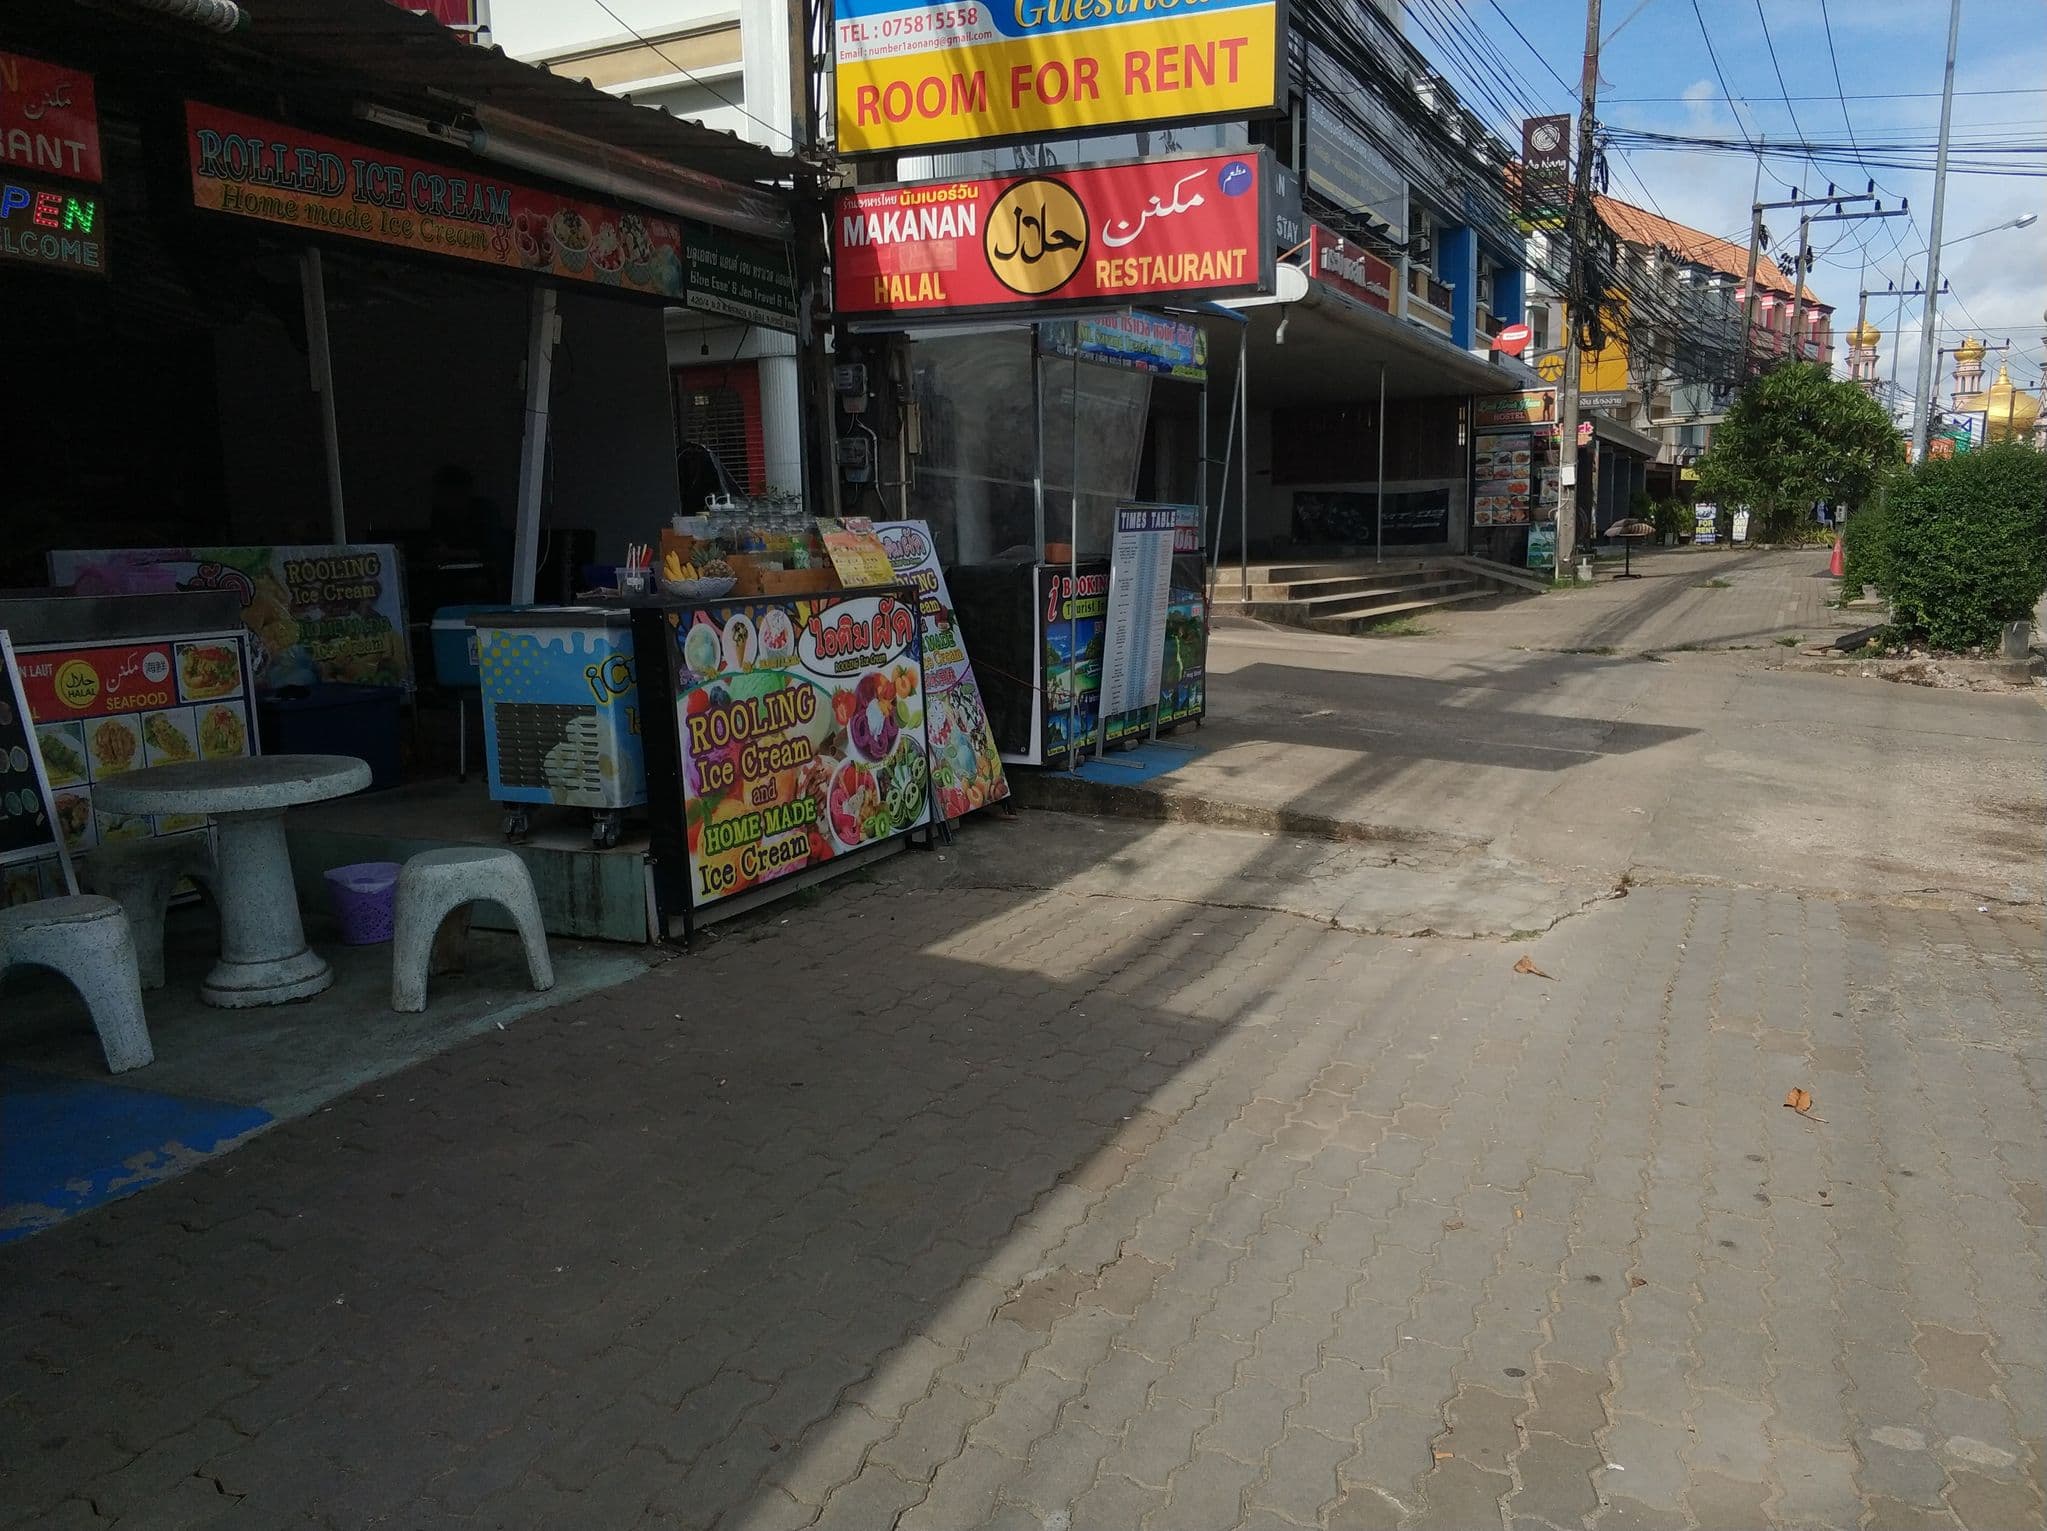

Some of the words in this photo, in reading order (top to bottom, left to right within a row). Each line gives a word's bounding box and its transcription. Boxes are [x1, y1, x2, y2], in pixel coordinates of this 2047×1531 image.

[840, 22, 869, 44] TEL
[882, 8, 978, 37] 075815558
[869, 31, 992, 56] number1aonang@gmail.com
[857, 71, 987, 127] ROOM
[1011, 57, 1100, 109] FOR
[1125, 37, 1248, 95] RENT
[0, 127, 87, 173] ANT
[196, 129, 346, 197] ROLLED
[352, 159, 407, 210] ICE
[410, 170, 512, 229] CREAM
[900, 184, 979, 206] นัมเบอร์วัน
[0, 184, 96, 235] PEN
[222, 183, 298, 219] Home
[304, 203, 374, 232] made
[380, 209, 414, 240] Ice
[420, 216, 488, 250] Cream
[843, 203, 977, 247] MAKANAN
[0, 226, 100, 267] LCOME
[994, 203, 1083, 264] حلال
[1096, 248, 1247, 288] RESTAURANT
[873, 271, 946, 304] HALAL
[1121, 511, 1147, 529] TIMES
[1151, 511, 1176, 528] TABLE
[1695, 526, 1716, 534] RENT
[1698, 519, 1714, 527] FOR
[286, 555, 379, 583] ROOLING
[295, 586, 320, 604] Ice
[323, 583, 378, 602] Cream
[919, 600, 941, 614] eam
[1066, 600, 1095, 616] Turist
[30, 663, 53, 678] LAUT
[68, 687, 96, 698] HALAL
[106, 691, 168, 712] SEAFOOD
[688, 684, 816, 754] ROOLING
[698, 760, 734, 794] Ice
[741, 737, 812, 782] Cream
[752, 778, 778, 806] and
[705, 812, 762, 855] HOME
[764, 797, 817, 838] MADE
[699, 861, 735, 896] Ice
[741, 835, 809, 879] Cream
